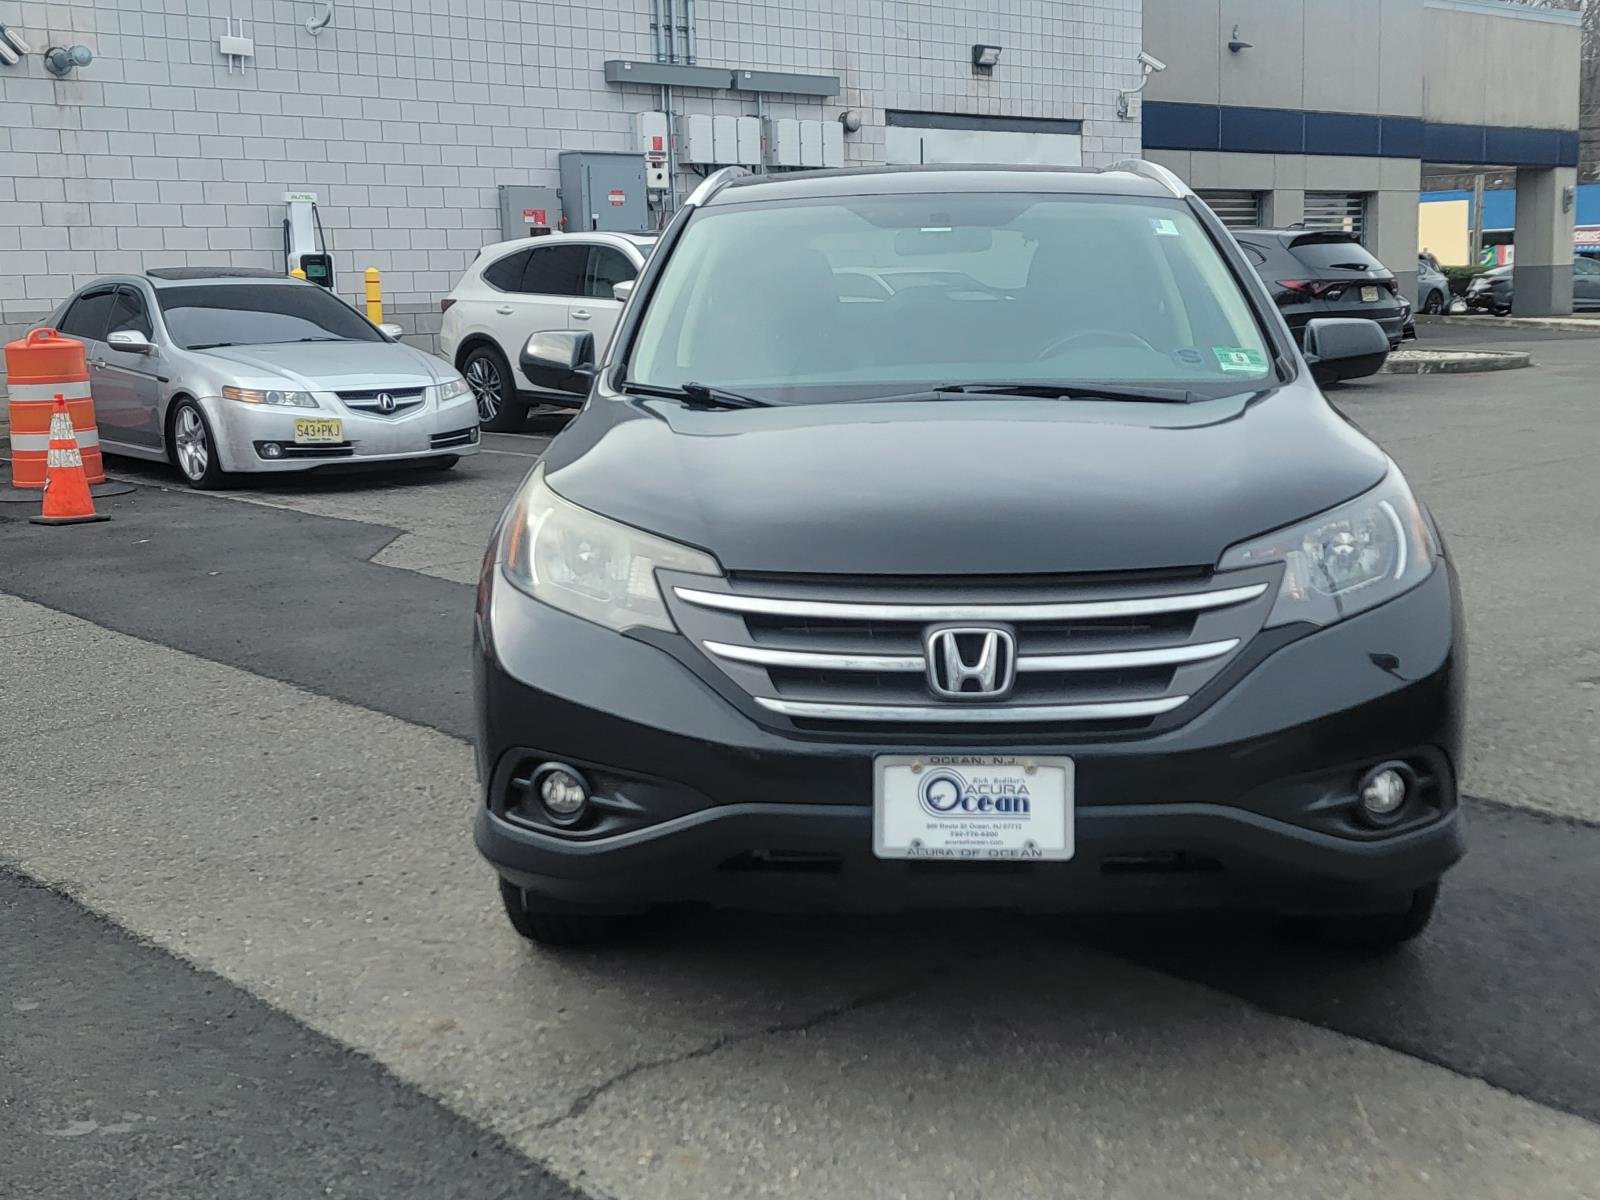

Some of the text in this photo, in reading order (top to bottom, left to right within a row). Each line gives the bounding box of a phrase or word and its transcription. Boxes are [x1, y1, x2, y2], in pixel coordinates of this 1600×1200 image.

[964, 784, 1030, 795] ACURA
[907, 848, 1043, 858] ACURA OF OCEAN
